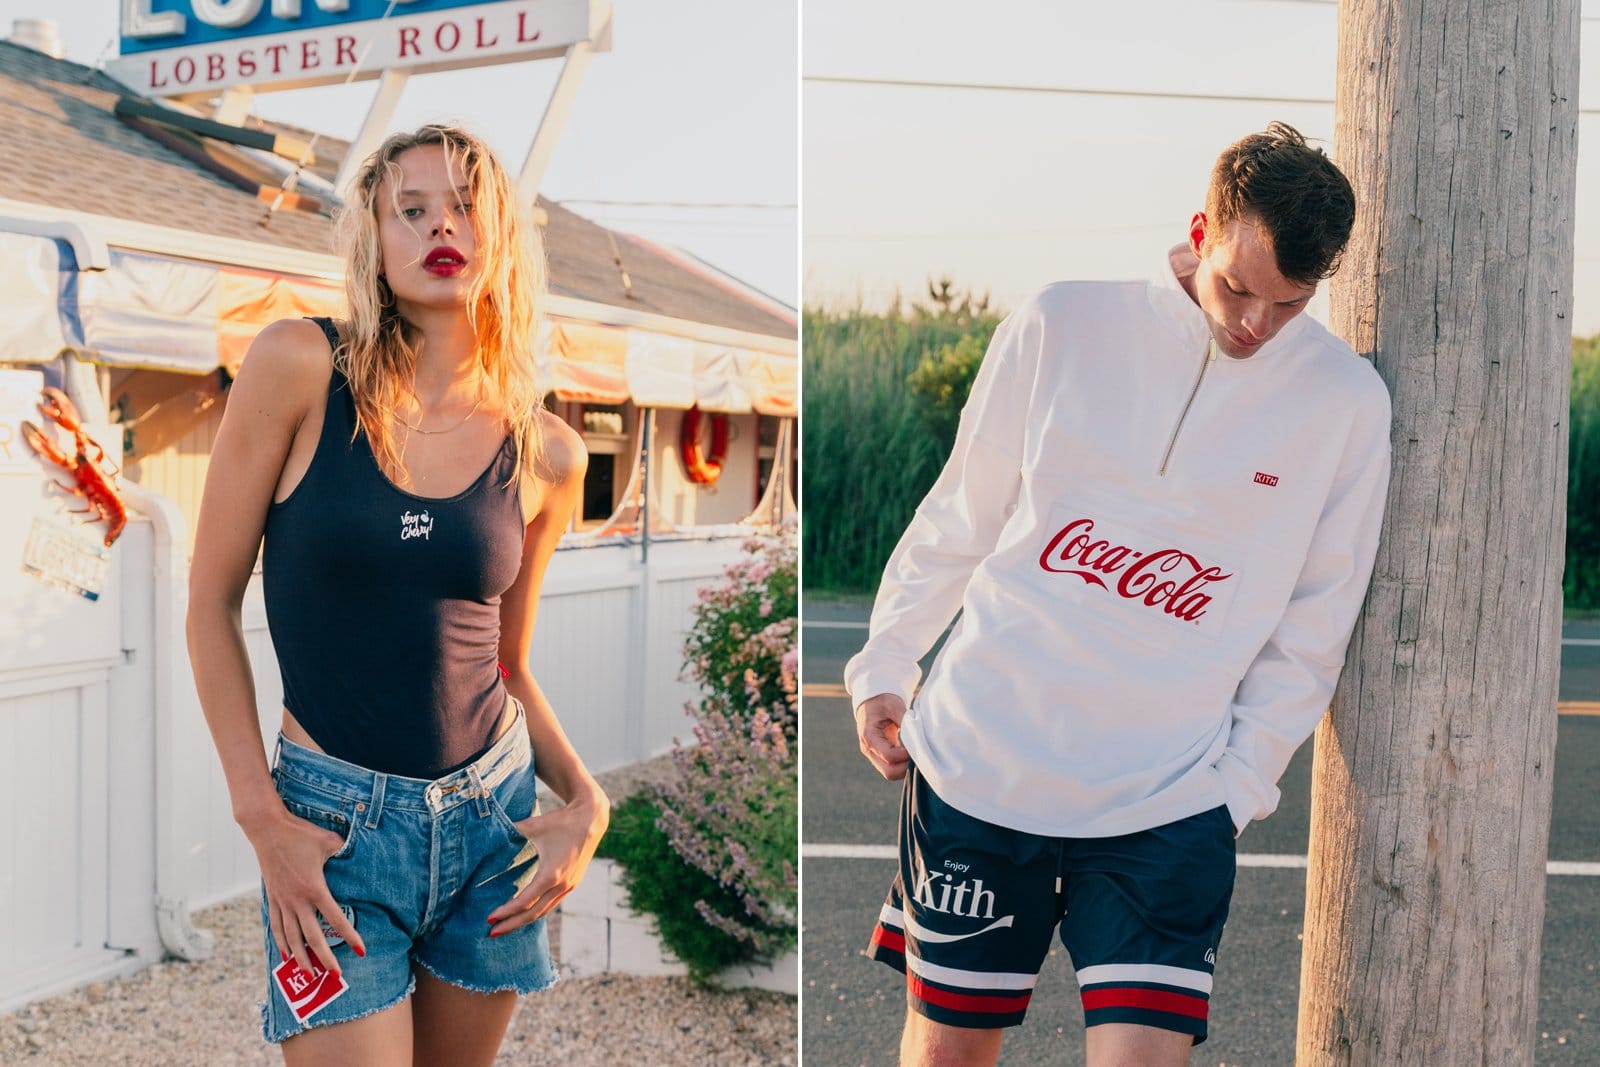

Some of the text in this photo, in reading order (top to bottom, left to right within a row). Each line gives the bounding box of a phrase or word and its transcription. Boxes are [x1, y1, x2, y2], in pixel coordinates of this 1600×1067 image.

[150, 36, 357, 88] LOBSTER
[398, 11, 541, 58] ROLL
[1255, 473, 1278, 486] KITH
[1039, 518, 1233, 622] Coca-Cola
[944, 860, 970, 873] Enjoy
[912, 869, 995, 918] Kith
